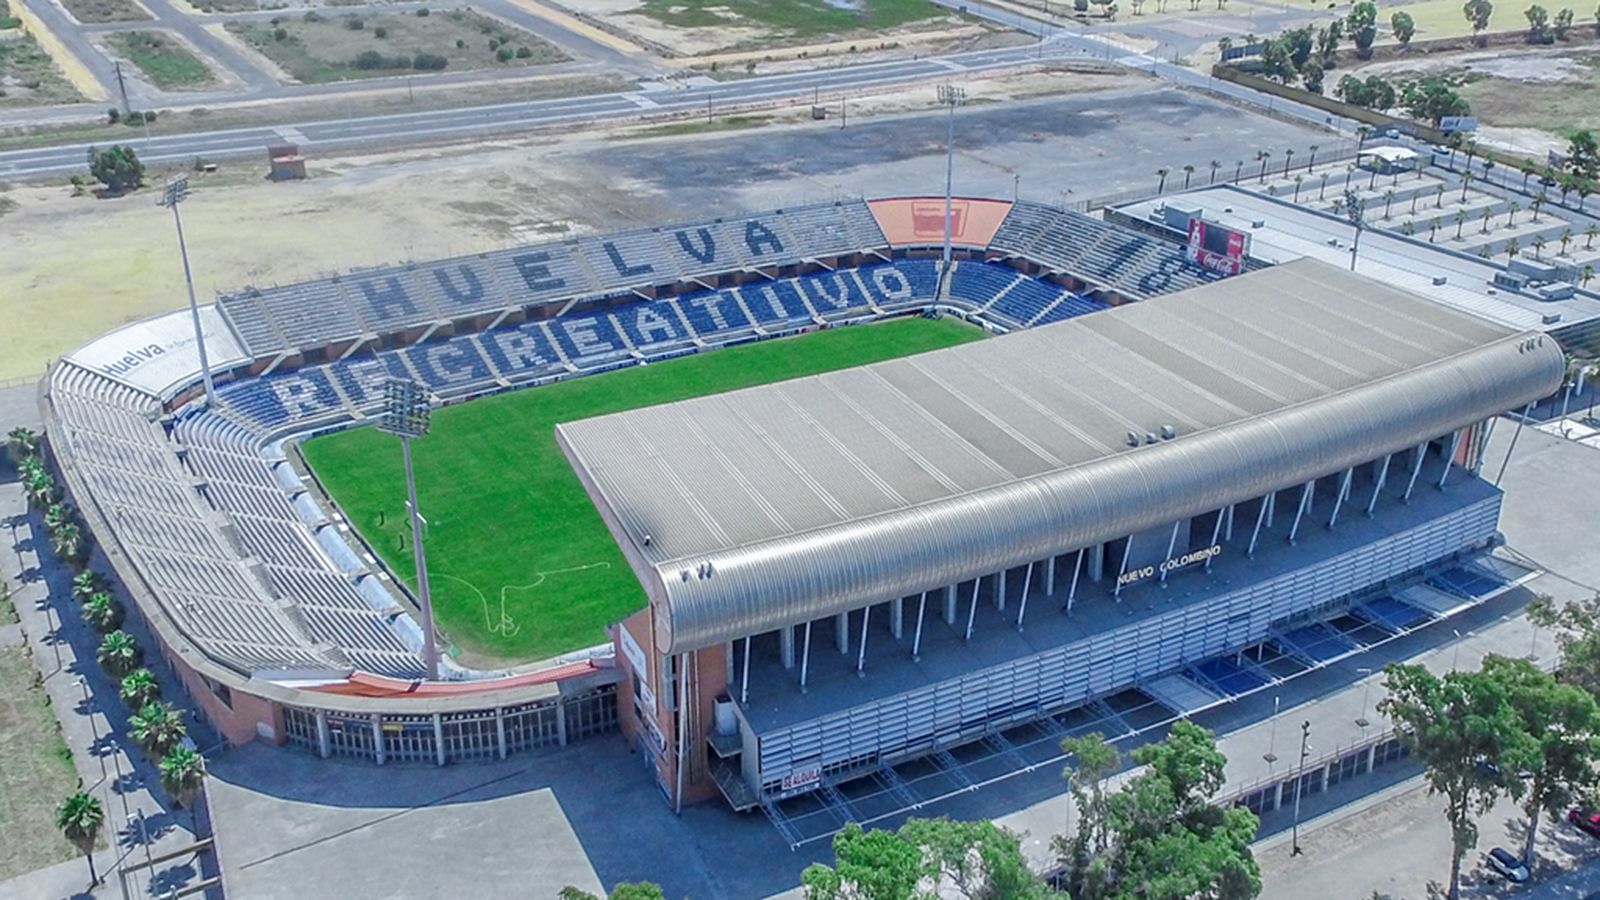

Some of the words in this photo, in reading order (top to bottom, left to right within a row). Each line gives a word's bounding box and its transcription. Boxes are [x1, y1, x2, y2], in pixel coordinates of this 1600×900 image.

[359, 220, 784, 320] HUELVA
[103, 343, 165, 378] Huelva
[269, 267, 913, 421] RECREATIVO
[1117, 566, 1154, 585] NUEVO
[1159, 544, 1221, 572] COLOMBINO
